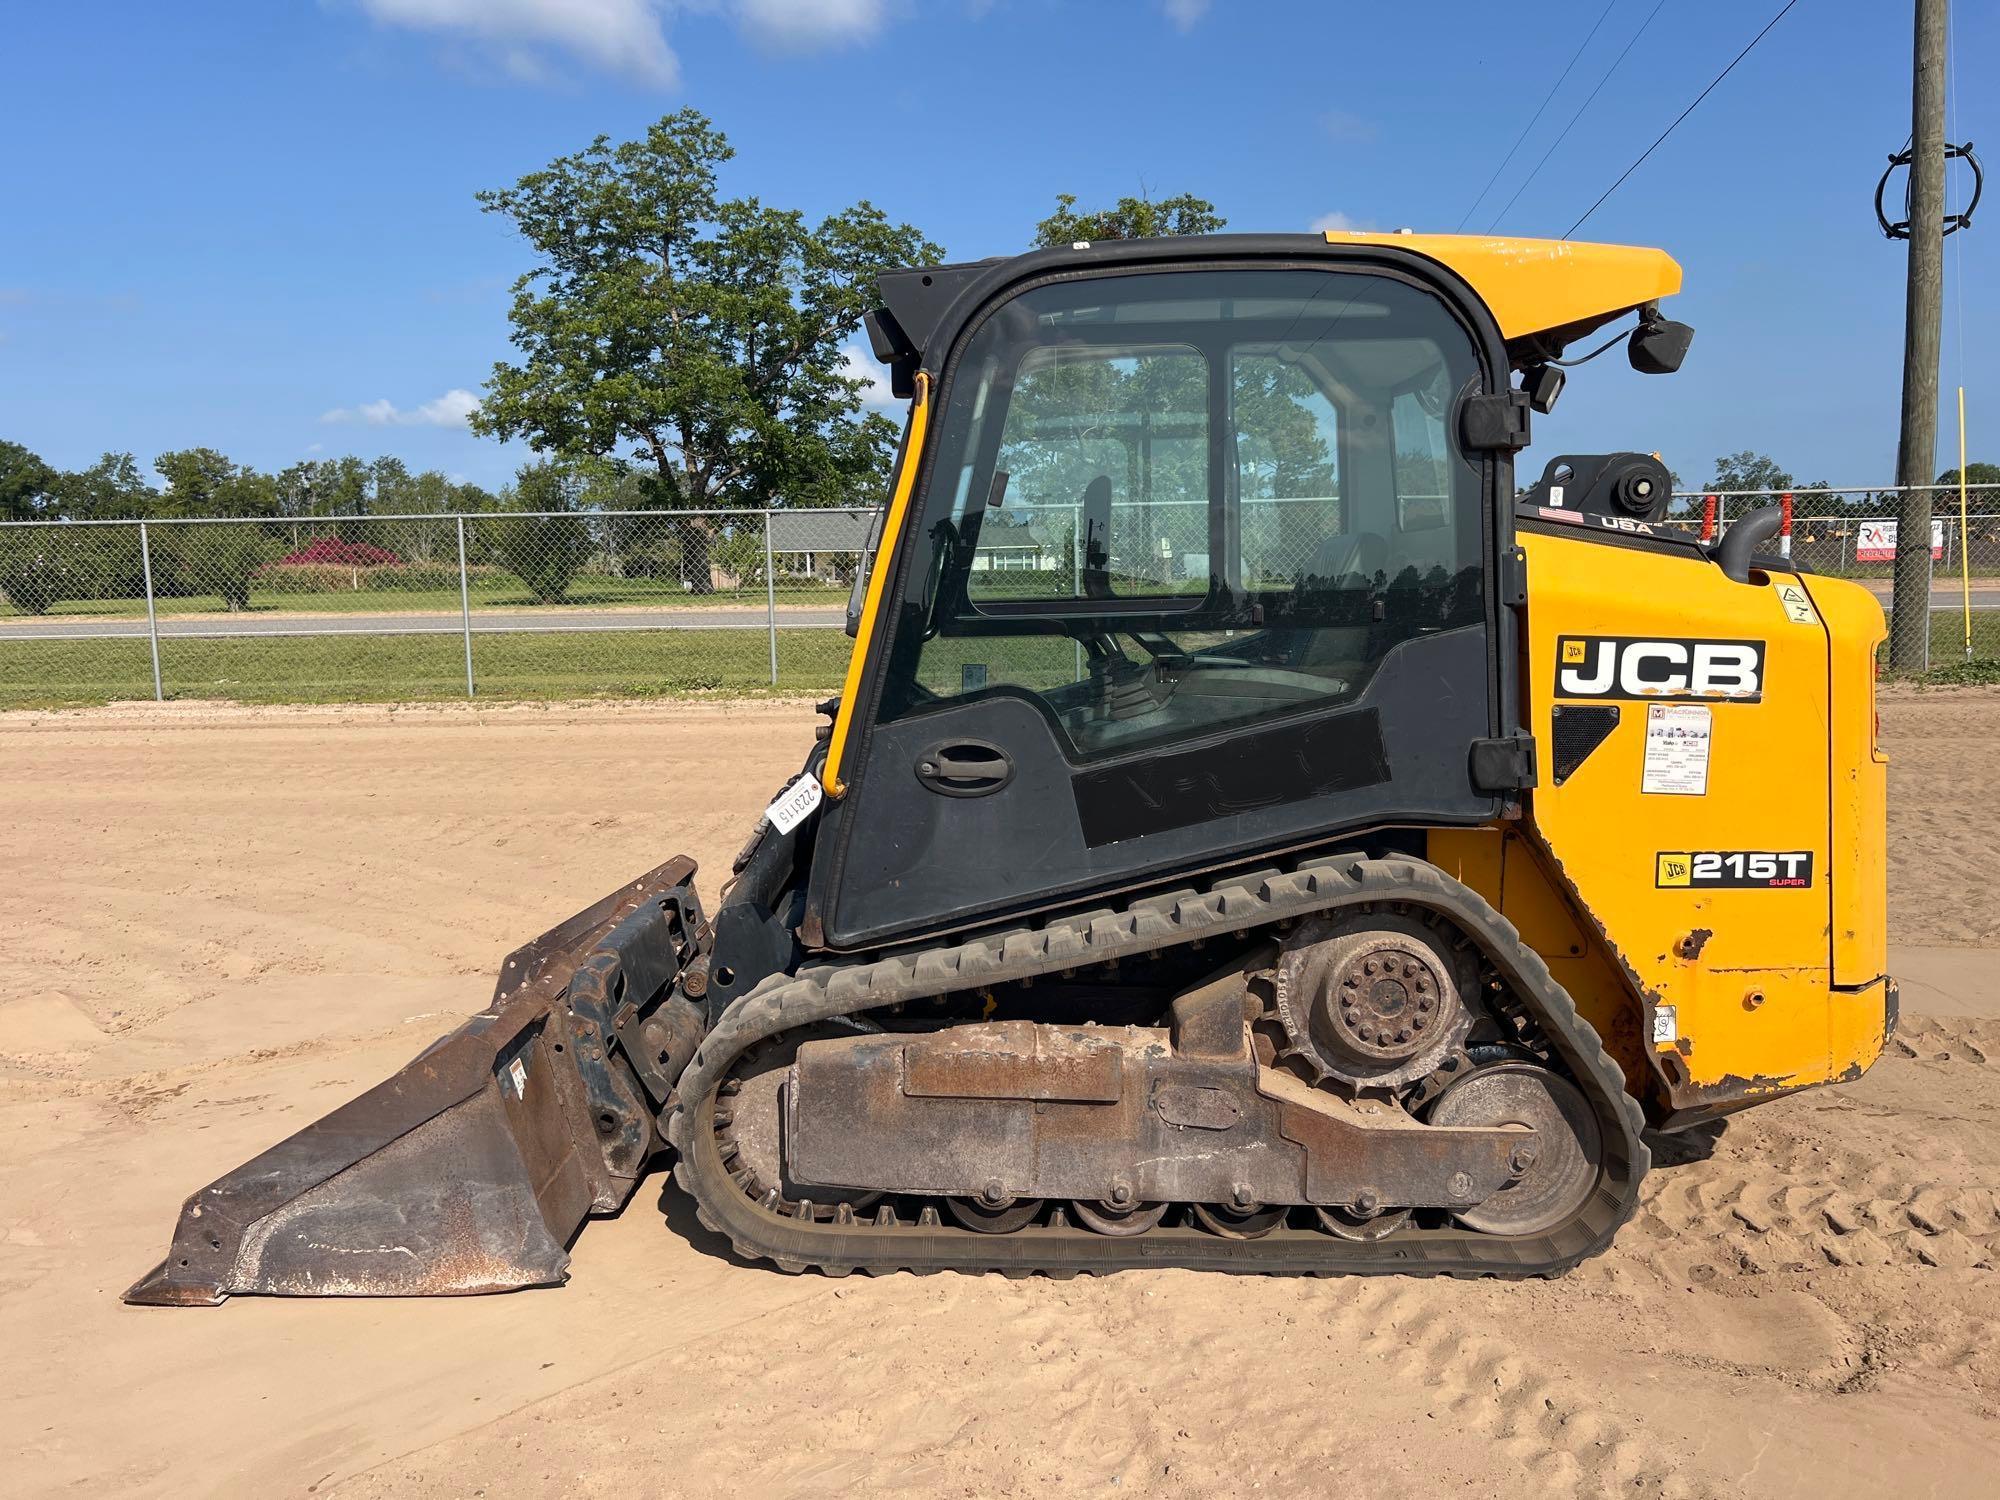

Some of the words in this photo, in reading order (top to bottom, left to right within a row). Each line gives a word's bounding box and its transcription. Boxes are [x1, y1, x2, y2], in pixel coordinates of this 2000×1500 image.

[1601, 517, 1654, 534] USA
[1568, 645, 1583, 657] JCB
[1561, 641, 1758, 697] JCB
[779, 789, 815, 824] 223115
[1668, 863, 1687, 878] JCB
[1693, 854, 1806, 879] 215T
